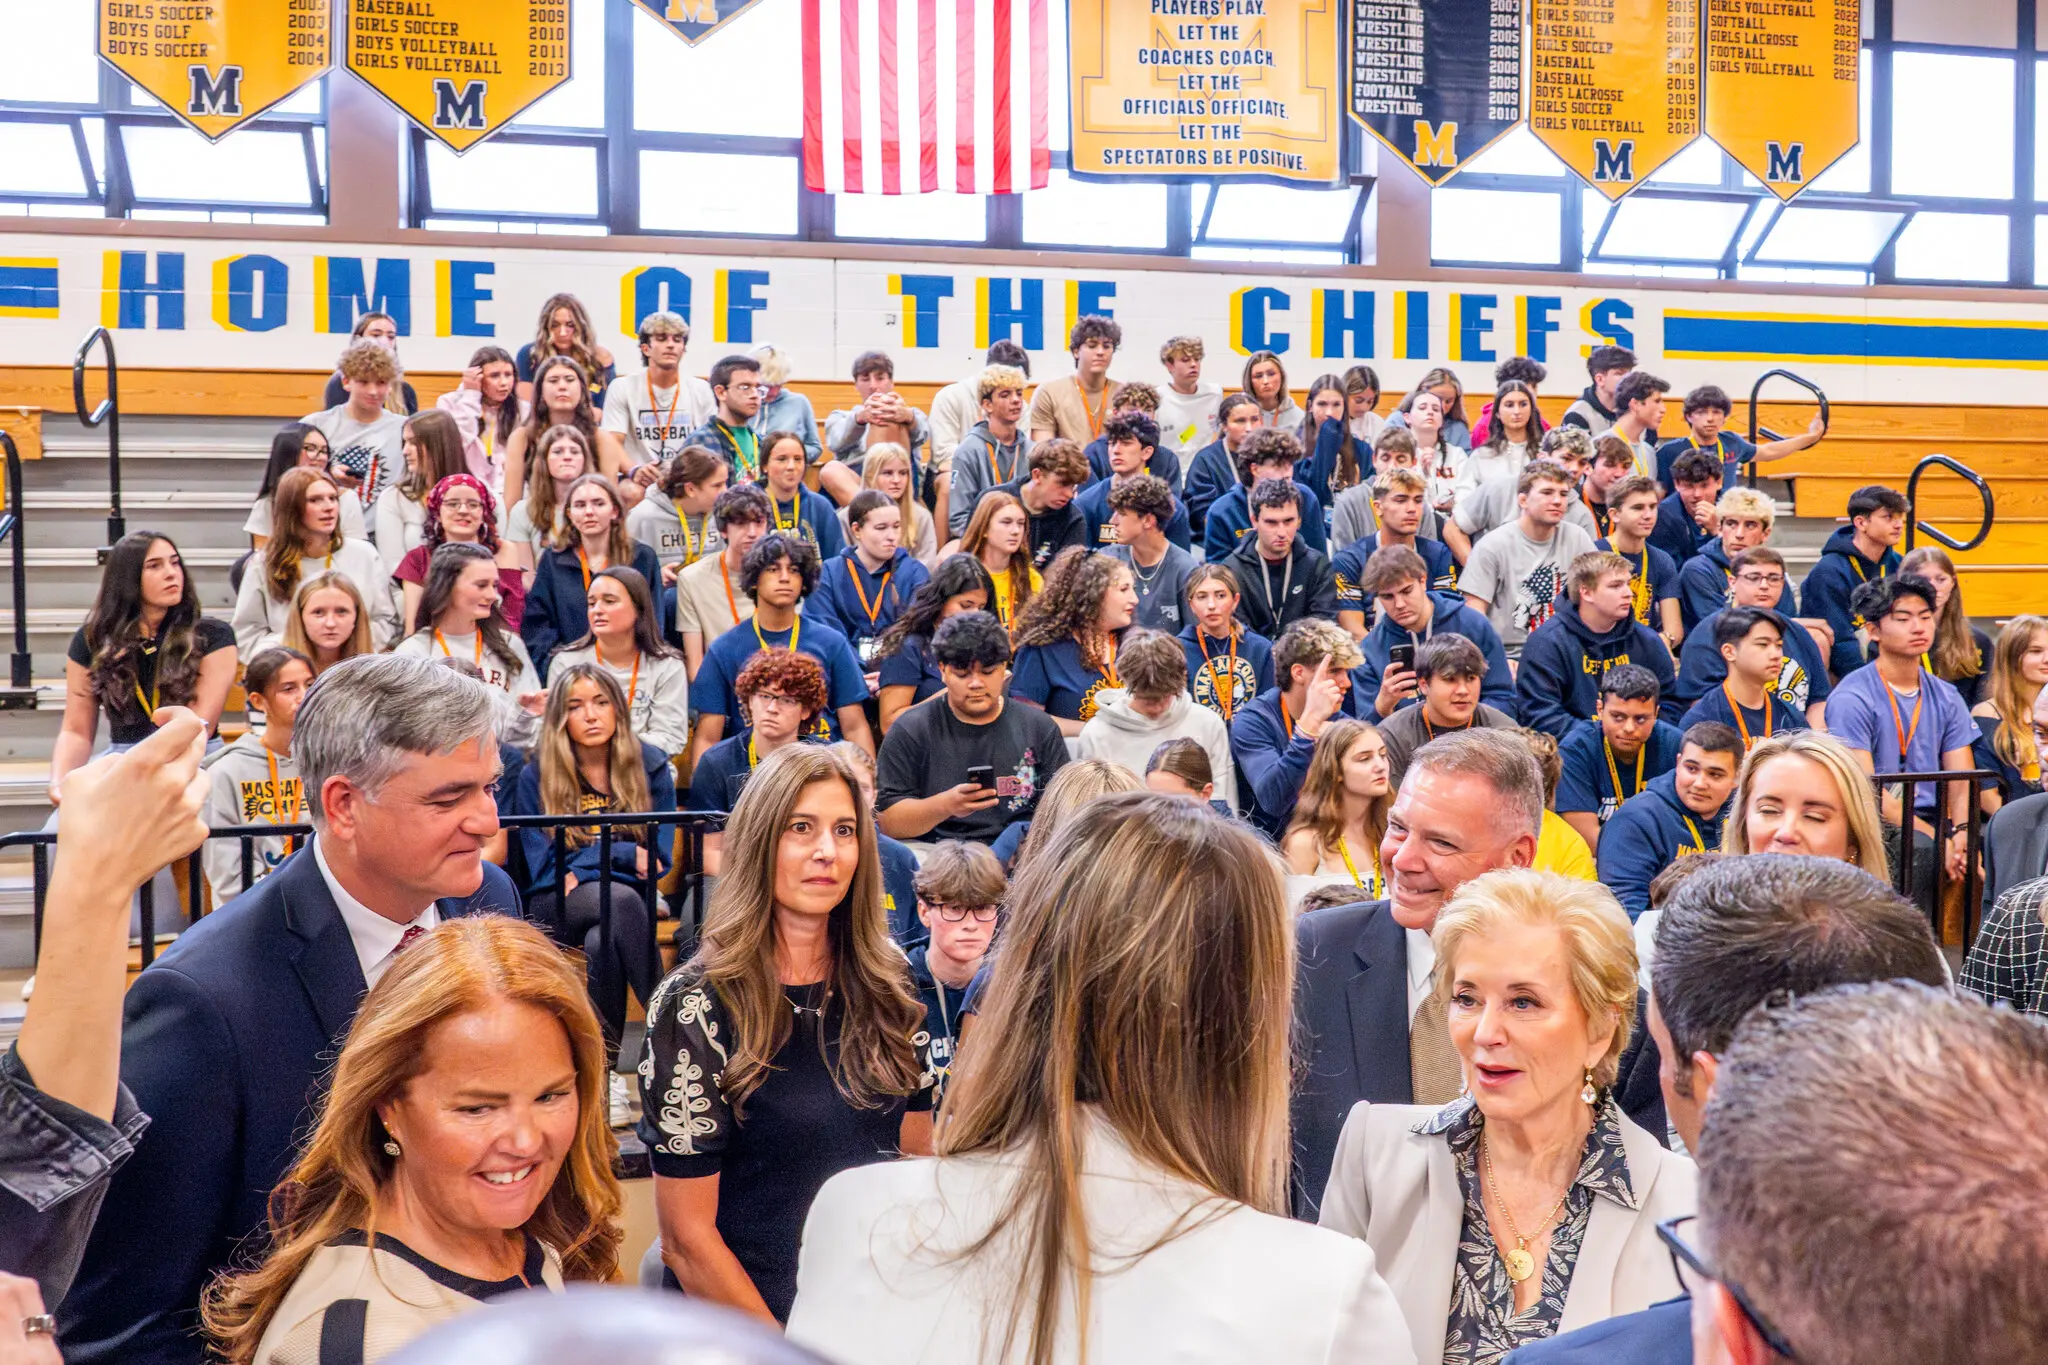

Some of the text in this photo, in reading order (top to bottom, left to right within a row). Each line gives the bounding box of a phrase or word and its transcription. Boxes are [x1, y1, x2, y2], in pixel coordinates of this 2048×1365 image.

[108, 3, 325, 29] GIRLS SOCCER 2003
[356, 0, 564, 23] BASEBALL 2009
[1152, 0, 1266, 16] PLAYERS PLAY.
[1356, 4, 1519, 28] WRESTLING 2004
[1536, 8, 1569, 21] GIRLS
[1573, 10, 1614, 24] SOCCER
[1667, 0, 1695, 13] 2015
[1710, 1, 1741, 13] GIRLS
[1745, 2, 1816, 18] VOLLEYBALL
[355, 17, 564, 41] GIRLS SOCCER 2010
[1179, 25, 1239, 40] LET THE
[1356, 20, 1519, 43] WRESTLING 2005
[1711, 15, 1766, 29] SOFTBALL
[108, 21, 324, 47] BOYS GOLF 2004
[1536, 24, 1695, 43] BASEBALL 2017
[1710, 30, 1741, 43] GIRLS
[1745, 32, 1799, 47] LACROSSE
[108, 40, 324, 66] BOYS SOCCER 2004
[356, 35, 564, 59] BOYS VOLLEYBALL 2011
[1138, 48, 1276, 67] COACHES COACH.
[1356, 36, 1519, 59] WRESTLING 2006
[1711, 45, 1766, 60] FOOTBALL
[355, 53, 564, 76] GIRLS VOLLEYBALL 2013
[1356, 51, 1519, 74] WRESTLING 2008
[1536, 54, 1695, 75] BASEBALL 2018
[1710, 60, 1740, 73] GIRLS
[1745, 62, 1815, 77] VOLLEYBALL
[1179, 75, 1240, 91] LET THE
[1355, 67, 1519, 90] WRESTLING 2009
[1536, 71, 1695, 90] BASEBALL 2019
[188, 65, 242, 115] M
[1355, 83, 1518, 105] FOOTBALL 2009
[1536, 86, 1695, 105] BOYS LACROSSE 2019
[433, 79, 487, 129] M
[1124, 98, 1289, 120] OFFICIALS OFFICIATE.
[1355, 98, 1518, 121] WRESTLING 2010
[1536, 100, 1695, 120] GIRLS SOCCER 2019
[1180, 125, 1241, 140] LET THE
[1536, 117, 1695, 134] GIRLS VOLLEYBALL 2021
[1413, 119, 1457, 167] M
[1104, 149, 1308, 171] SPECTATORS BE POSITIVE.
[1593, 139, 1635, 182] M
[1766, 142, 1804, 183] M
[101, 249, 1635, 363] HOME OF THE CHIEFS
